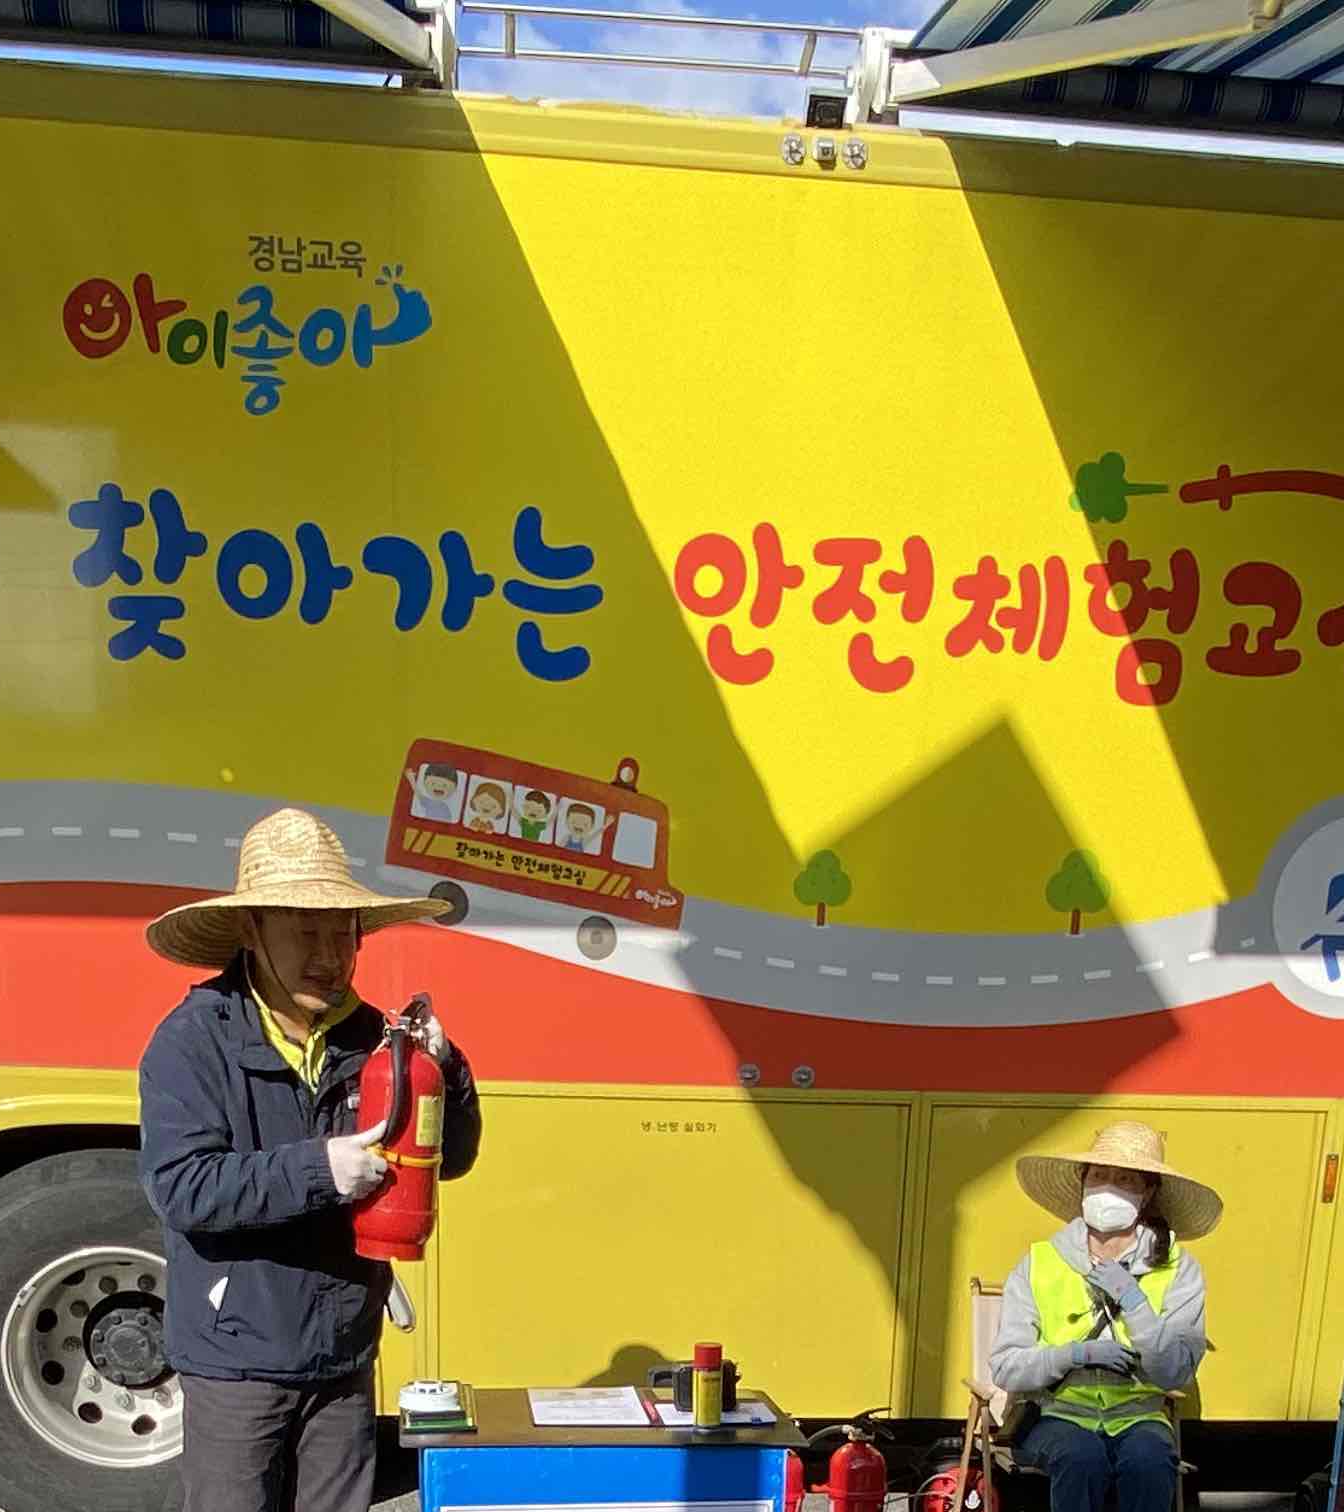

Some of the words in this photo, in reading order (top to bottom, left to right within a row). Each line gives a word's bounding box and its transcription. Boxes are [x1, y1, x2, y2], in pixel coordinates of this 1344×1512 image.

[248, 235, 367, 278] 경남교육
[62, 270, 433, 416] 아이좋아
[68, 482, 604, 683] 찾아가는
